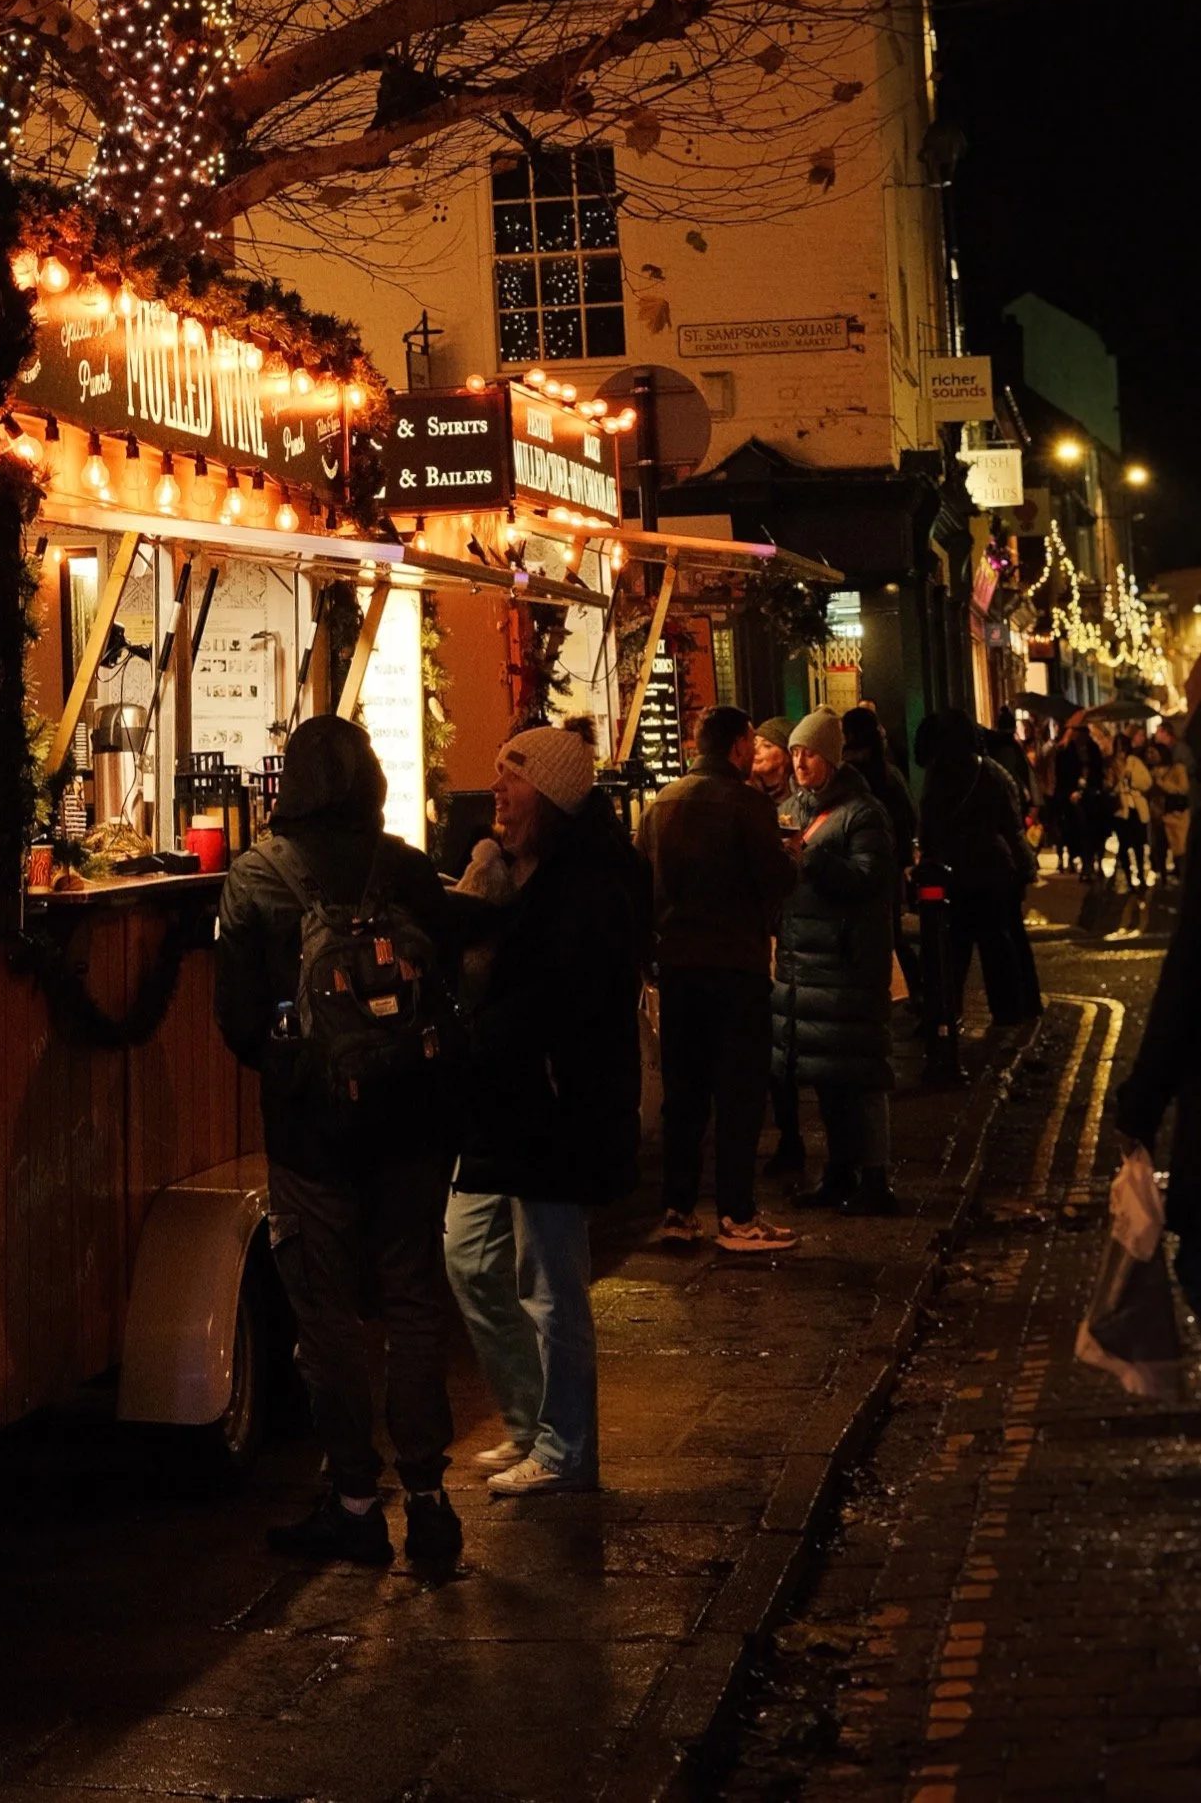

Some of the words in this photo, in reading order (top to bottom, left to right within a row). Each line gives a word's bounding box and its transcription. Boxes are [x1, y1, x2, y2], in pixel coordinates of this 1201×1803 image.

[683, 330, 703, 342] ST.
[706, 326, 781, 342] SAMPSON'S
[787, 322, 842, 337] SQUARE
[78, 353, 112, 403] Punch
[124, 299, 213, 438] MULLED
[211, 325, 269, 460] WINE
[931, 372, 977, 386] richer
[931, 385, 987, 398] sounds
[397, 418, 415, 438] &
[976, 455, 1010, 469] FISH
[399, 468, 417, 489] &
[987, 472, 998, 484] &
